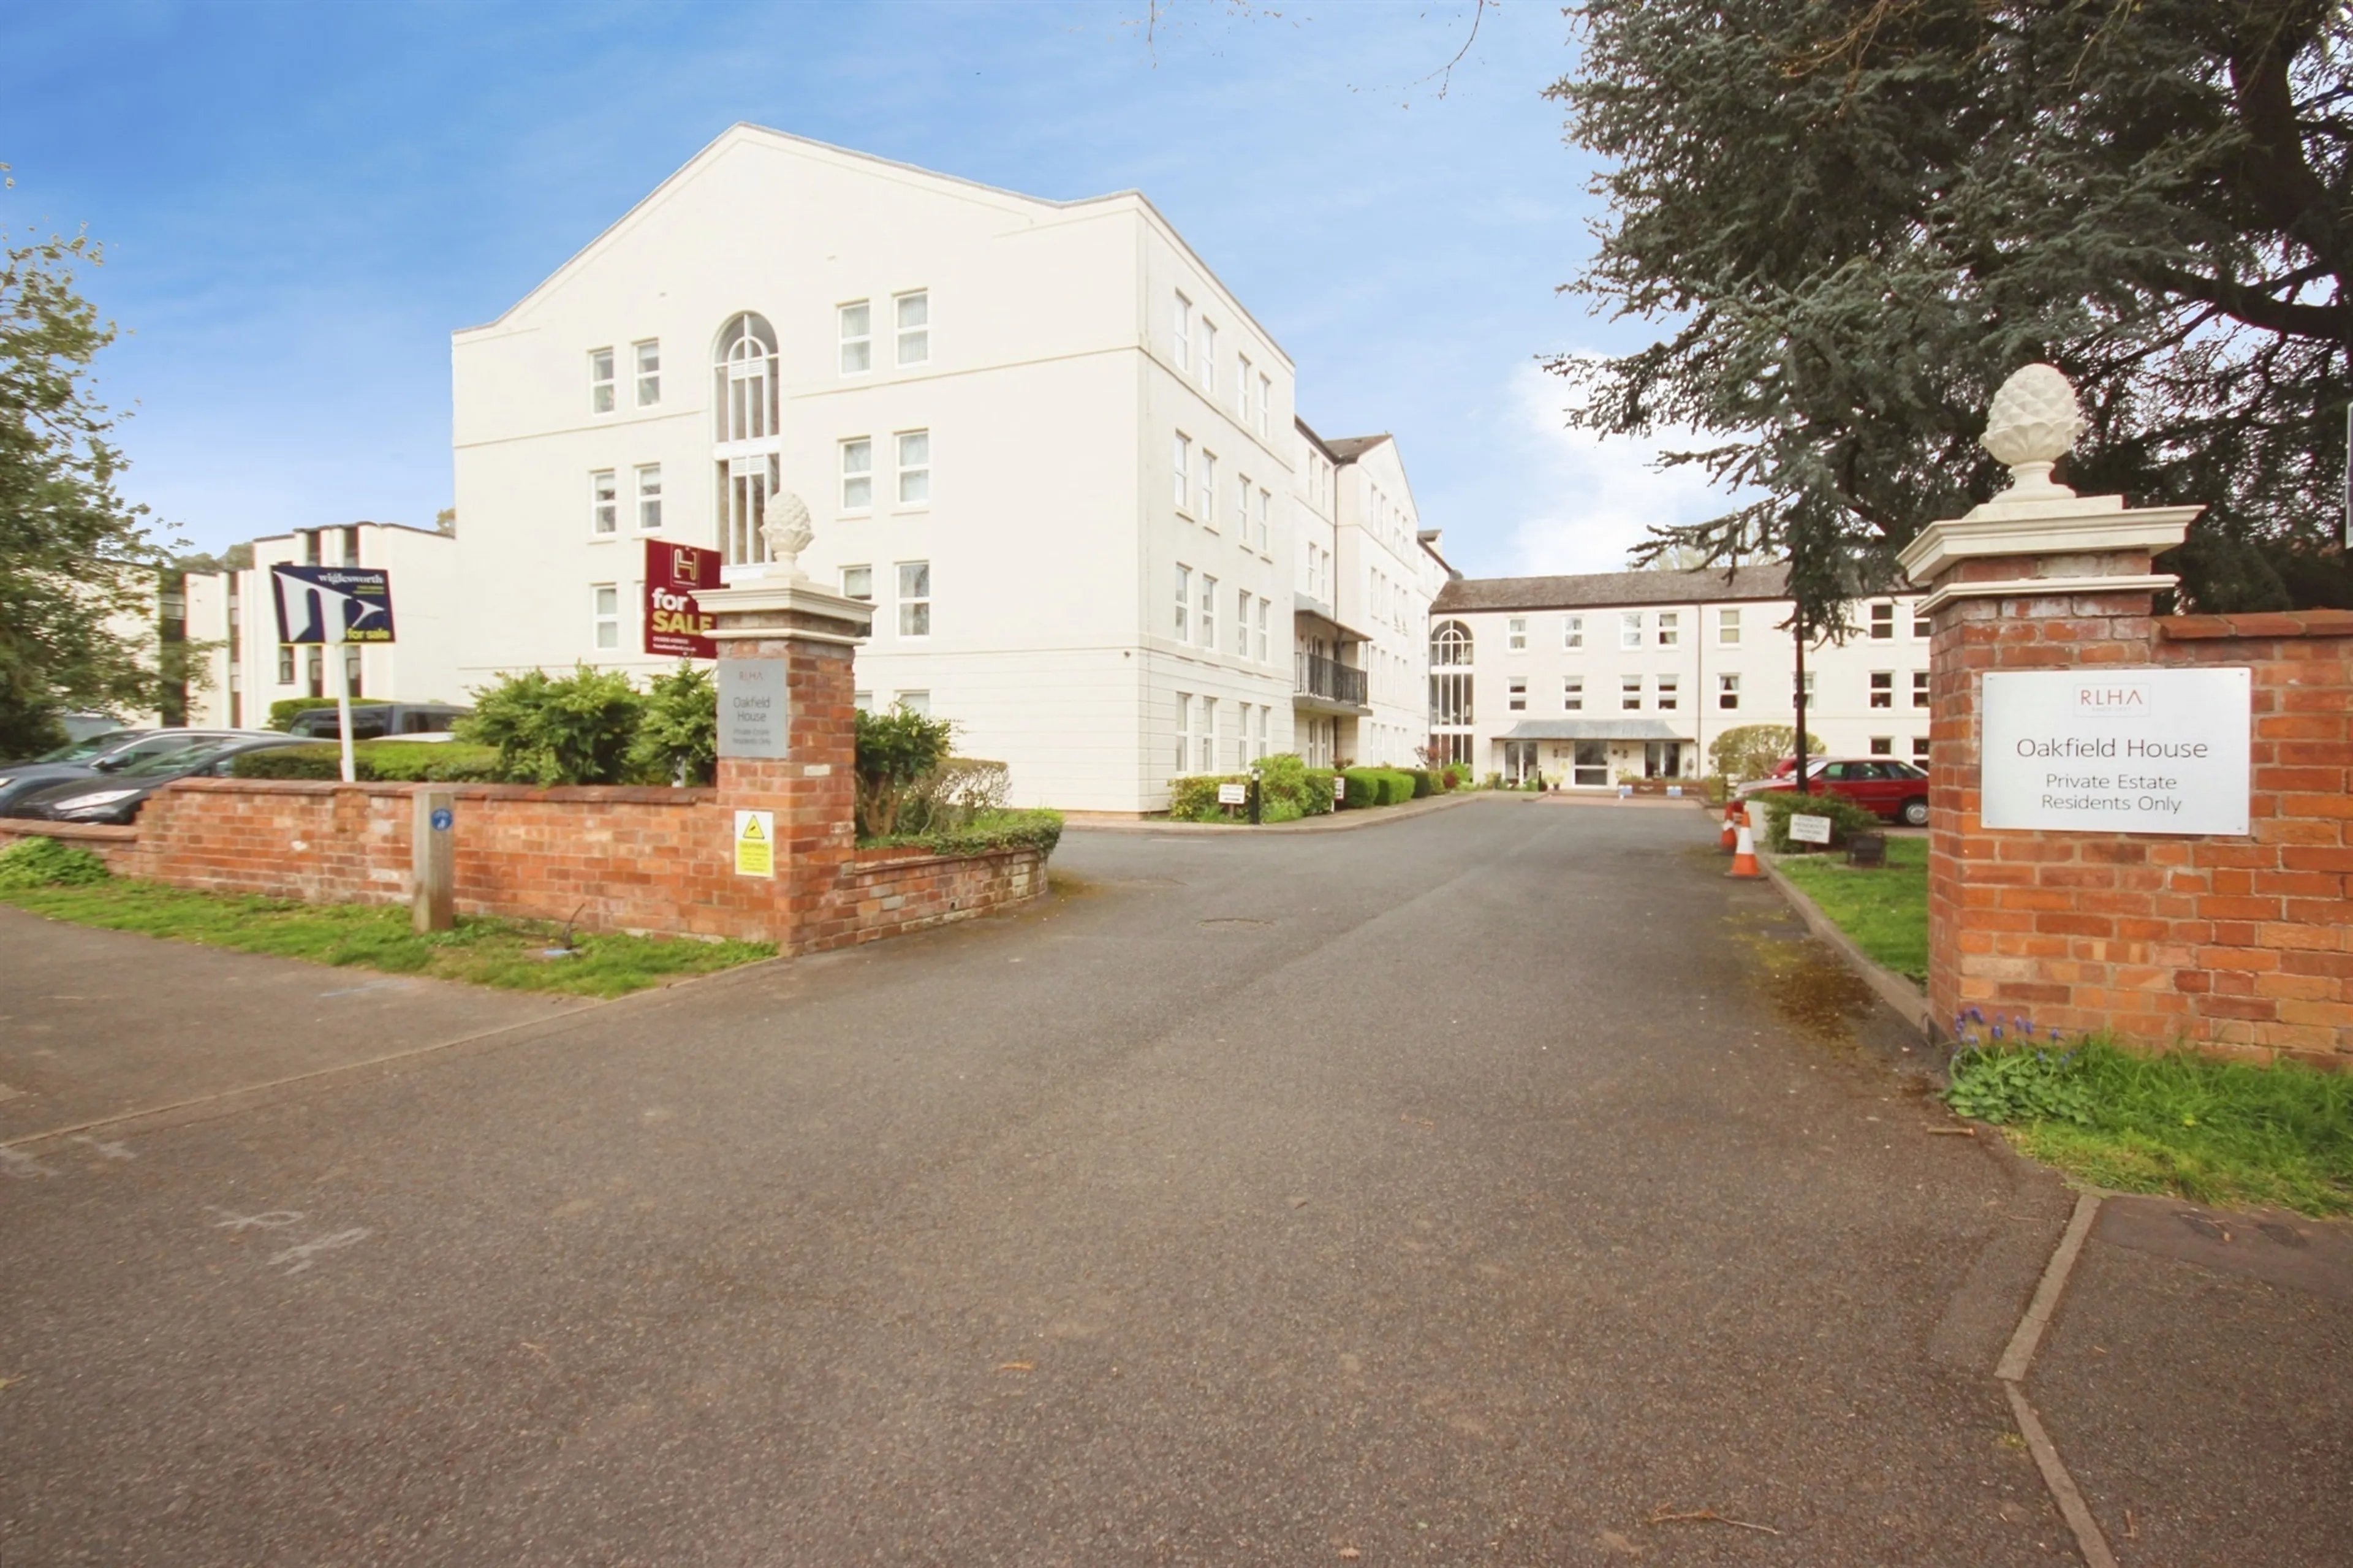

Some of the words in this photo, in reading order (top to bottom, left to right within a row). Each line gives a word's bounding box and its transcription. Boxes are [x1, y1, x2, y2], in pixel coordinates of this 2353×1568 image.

[318, 573, 384, 585] wigglesworth
[651, 587, 688, 611] for
[347, 628, 365, 639] for
[366, 628, 390, 640] sale
[733, 696, 770, 708] Oakfield
[2081, 689, 2143, 705] RLHA
[737, 711, 767, 722] House
[2017, 738, 2115, 757] Oakfield
[2128, 739, 2208, 758] House
[2047, 773, 2110, 789] Private
[2118, 775, 2177, 790] Estate
[2042, 795, 2131, 810] Residents
[2138, 796, 2181, 814] Only
